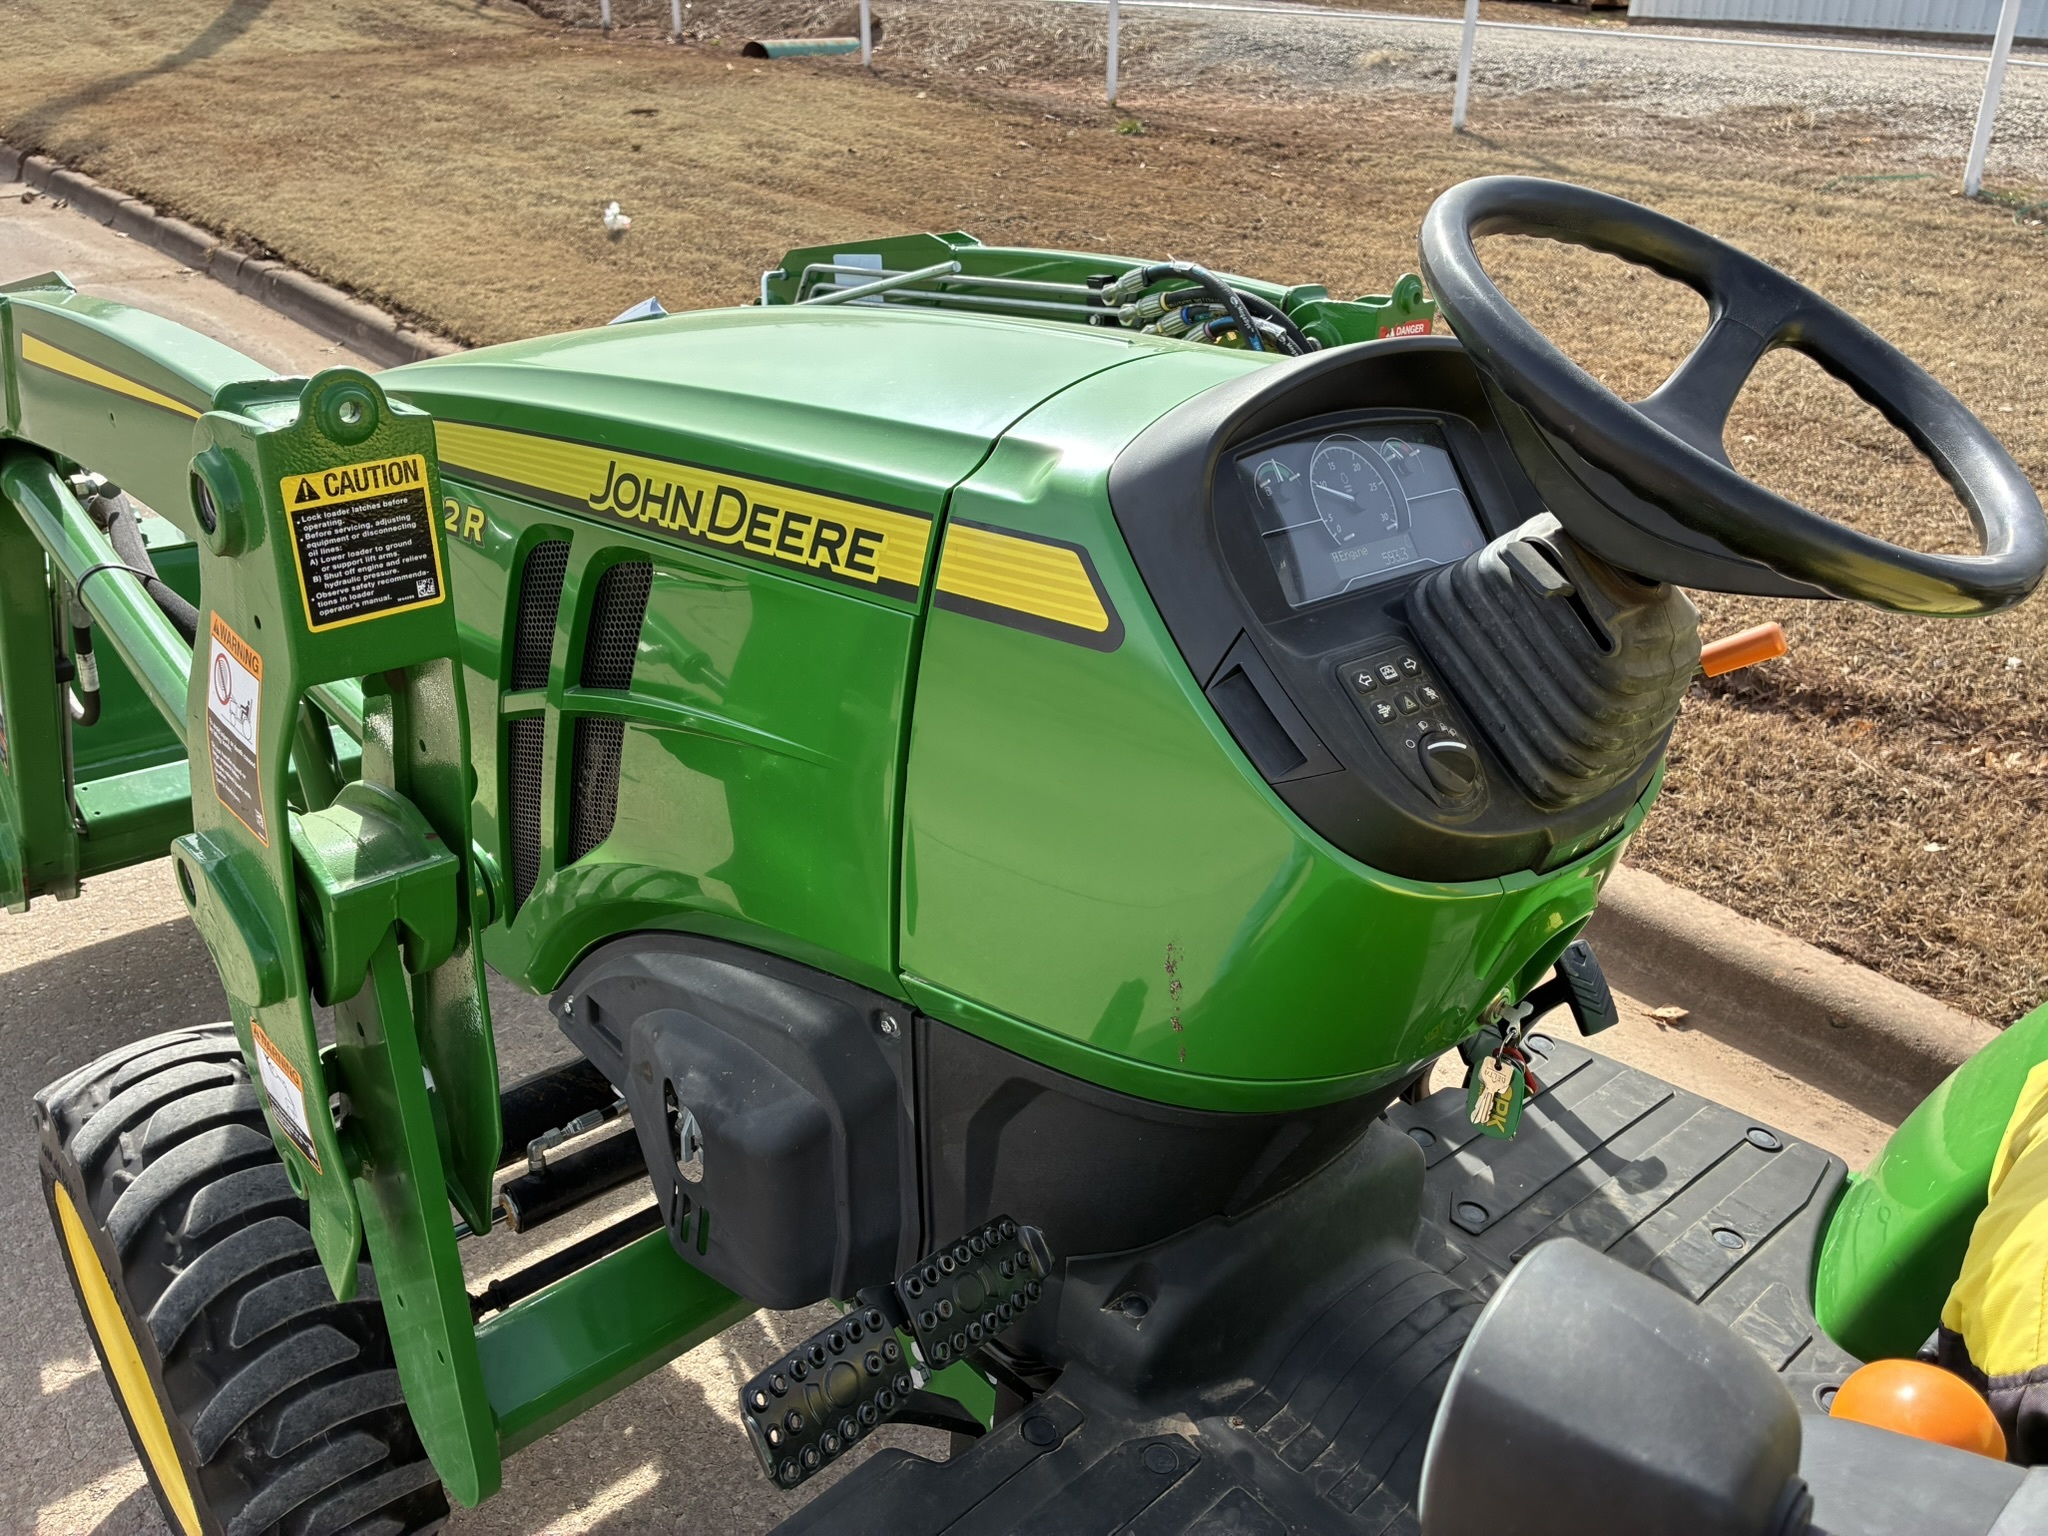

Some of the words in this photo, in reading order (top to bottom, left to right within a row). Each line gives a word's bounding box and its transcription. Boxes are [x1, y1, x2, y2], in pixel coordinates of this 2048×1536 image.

[1396, 323, 1425, 336] DANGER
[324, 459, 419, 497] CAUTION
[1353, 463, 1361, 472] 20
[1369, 483, 1378, 491] 25
[301, 513, 322, 523] Lock
[324, 508, 350, 519] loader
[352, 502, 381, 514] latches
[383, 498, 409, 508] before
[588, 460, 705, 530] JOHN
[707, 484, 886, 576] DEERE
[1328, 514, 1334, 522] 5
[1381, 513, 1389, 521] 30
[303, 518, 346, 532] operating.
[304, 530, 332, 541] Before
[334, 522, 374, 536] servicing,
[375, 514, 412, 527] adjusting
[306, 535, 350, 549] equipment
[351, 532, 361, 540] or
[362, 522, 417, 537] disconnecting
[308, 547, 319, 558] oil
[320, 545, 343, 556] lines:
[310, 558, 319, 567] A)
[320, 553, 346, 564] Lower
[347, 548, 373, 558] loader
[375, 545, 384, 553] to
[385, 539, 413, 552] ground
[1339, 547, 1369, 562] Engine
[312, 575, 322, 584] B)
[323, 571, 343, 581] Shut
[344, 568, 356, 577] off
[357, 562, 384, 574] engine
[386, 558, 401, 568] and
[402, 553, 428, 564] relieve
[321, 565, 330, 573] or
[332, 558, 364, 571] support
[365, 555, 377, 564] lift
[378, 552, 401, 561] arms.
[315, 588, 350, 600] Observe
[351, 581, 376, 592] safety
[377, 570, 431, 586] recommenda-
[323, 576, 362, 590] hydraulic
[363, 569, 401, 582] pressure.
[317, 598, 339, 608] tions
[339, 595, 348, 604] in
[349, 590, 375, 601] loader
[319, 603, 361, 617] operator's
[361, 594, 394, 606] manual.
[220, 622, 261, 675] WARNING
